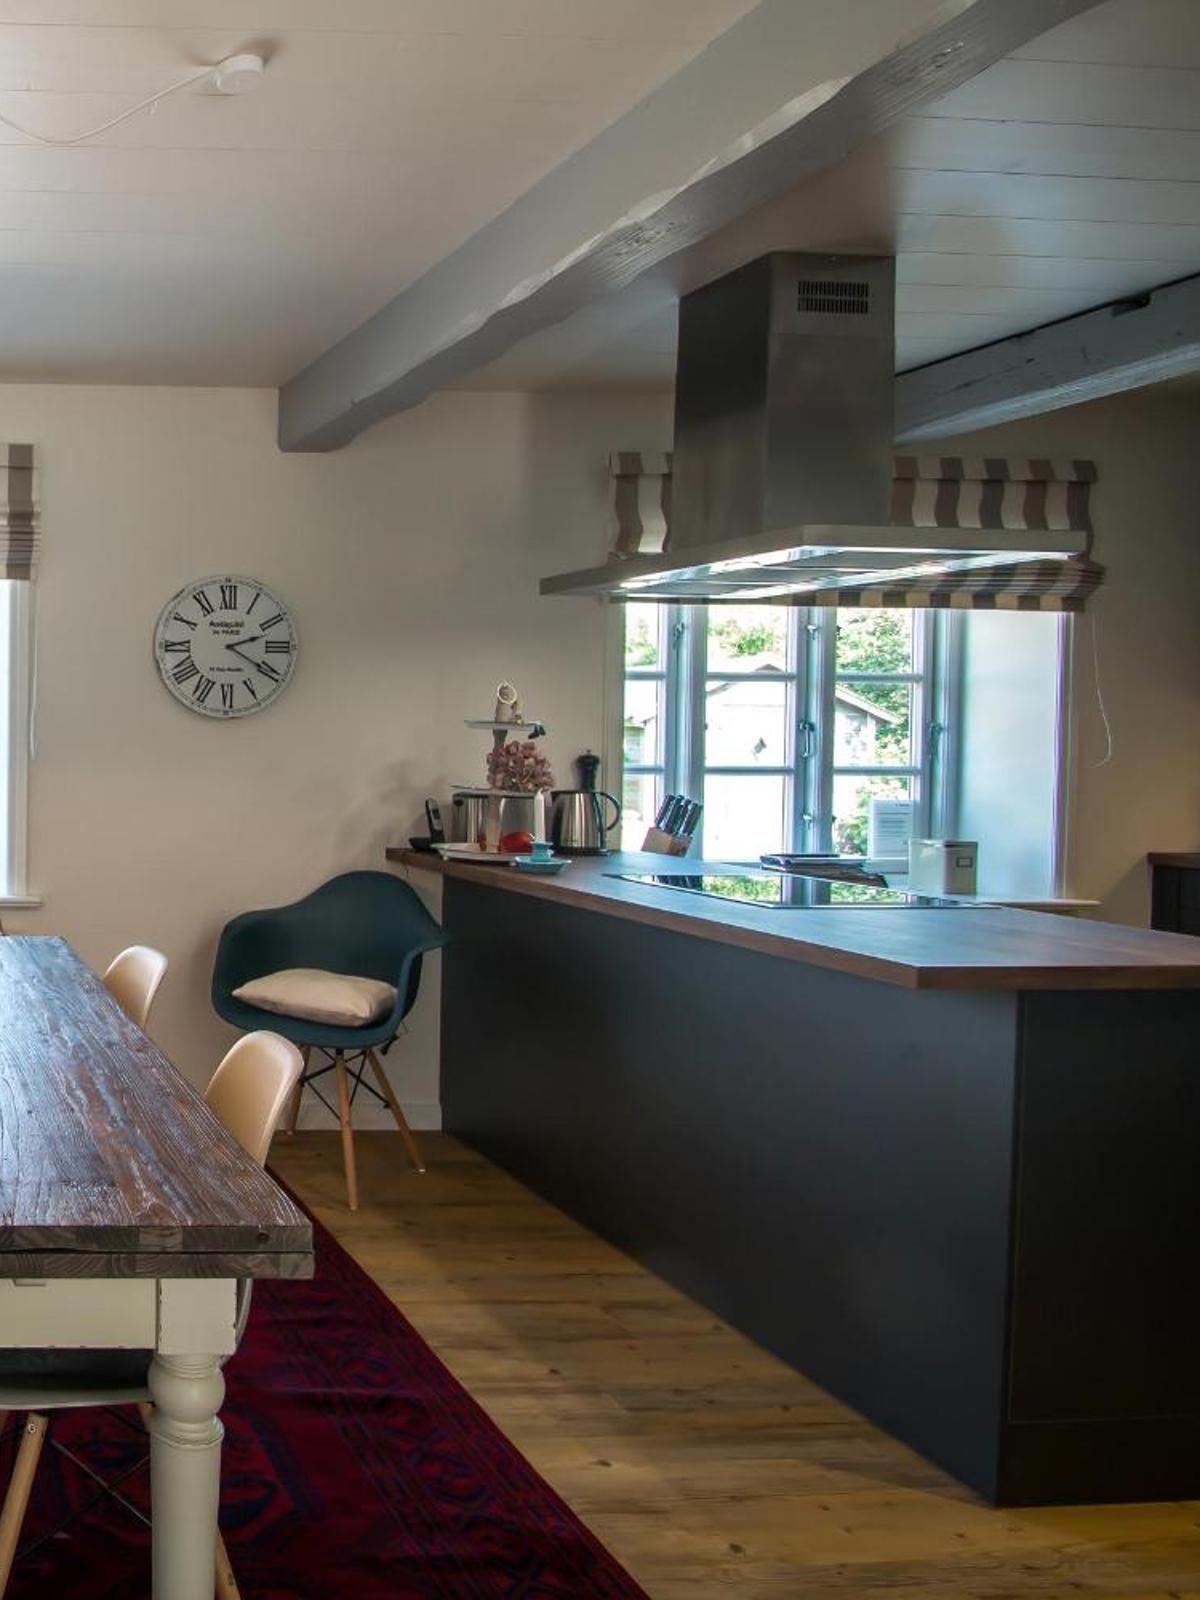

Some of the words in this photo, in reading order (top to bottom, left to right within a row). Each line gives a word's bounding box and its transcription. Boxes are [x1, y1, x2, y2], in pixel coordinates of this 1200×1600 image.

[193, 590, 214, 617] XI
[220, 585, 238, 610] XII
[173, 612, 198, 631] X
[259, 613, 284, 632] II
[164, 640, 191, 653] IX
[265, 640, 290, 653] III
[172, 654, 200, 685] VIII
[192, 674, 216, 703] VII
[220, 683, 233, 709] VI
[243, 677, 257, 701] V
